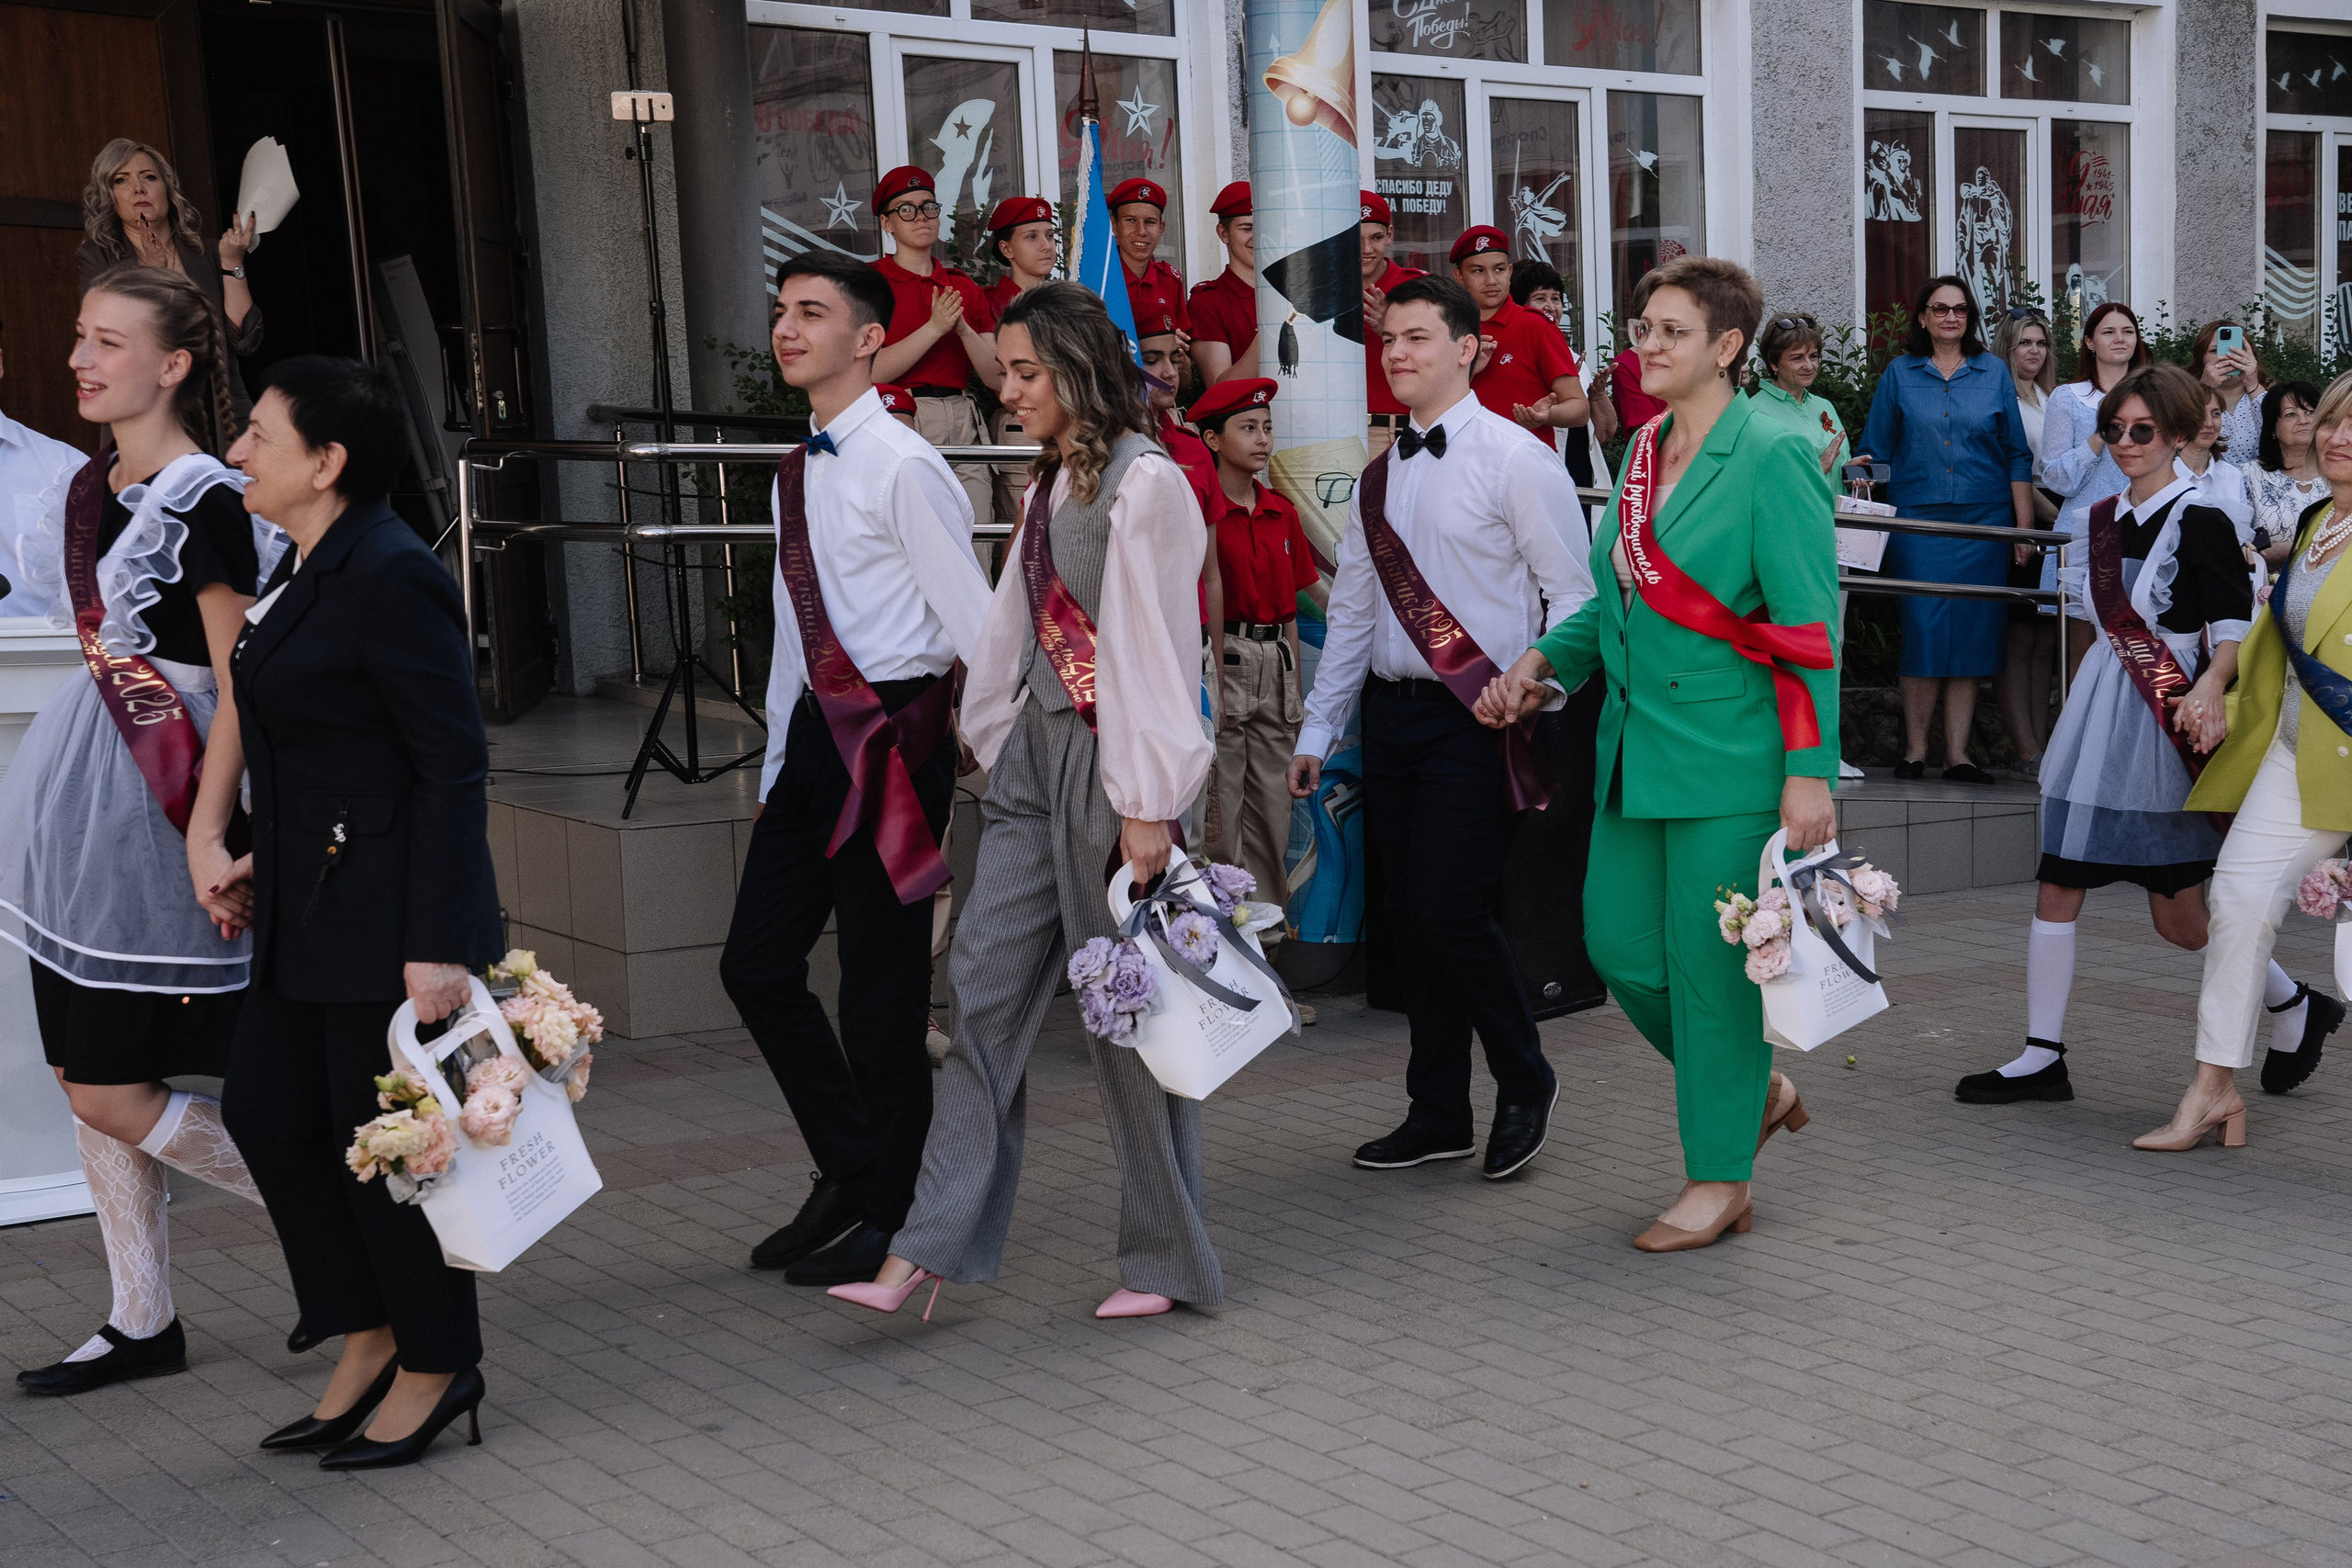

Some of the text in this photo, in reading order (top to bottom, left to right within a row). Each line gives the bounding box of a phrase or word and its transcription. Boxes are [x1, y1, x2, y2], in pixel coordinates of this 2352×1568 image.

[1406, 1, 1470, 50] Победы!
[1374, 178, 1453, 197] СПАСИБО ДЕДУ
[2067, 150, 2091, 194] 9
[2093, 179, 2114, 191] 1945
[1401, 197, 1446, 216] ПОБЕДУ!
[1623, 423, 1663, 586] Классный руководитель
[1365, 484, 1464, 649] Выпускник 2025
[783, 489, 865, 697] Выпускник 2025
[1023, 558, 1077, 661] руководитель
[111, 660, 186, 727] 2025
[1065, 679, 1082, 704] №40
[2141, 659, 2188, 707] 202
[1818, 966, 1856, 989] FLOW
[1822, 958, 1848, 976] FRE
[1197, 978, 1239, 1014] FRH
[495, 1139, 556, 1190] FLOWER
[498, 1130, 545, 1172] FRESH
